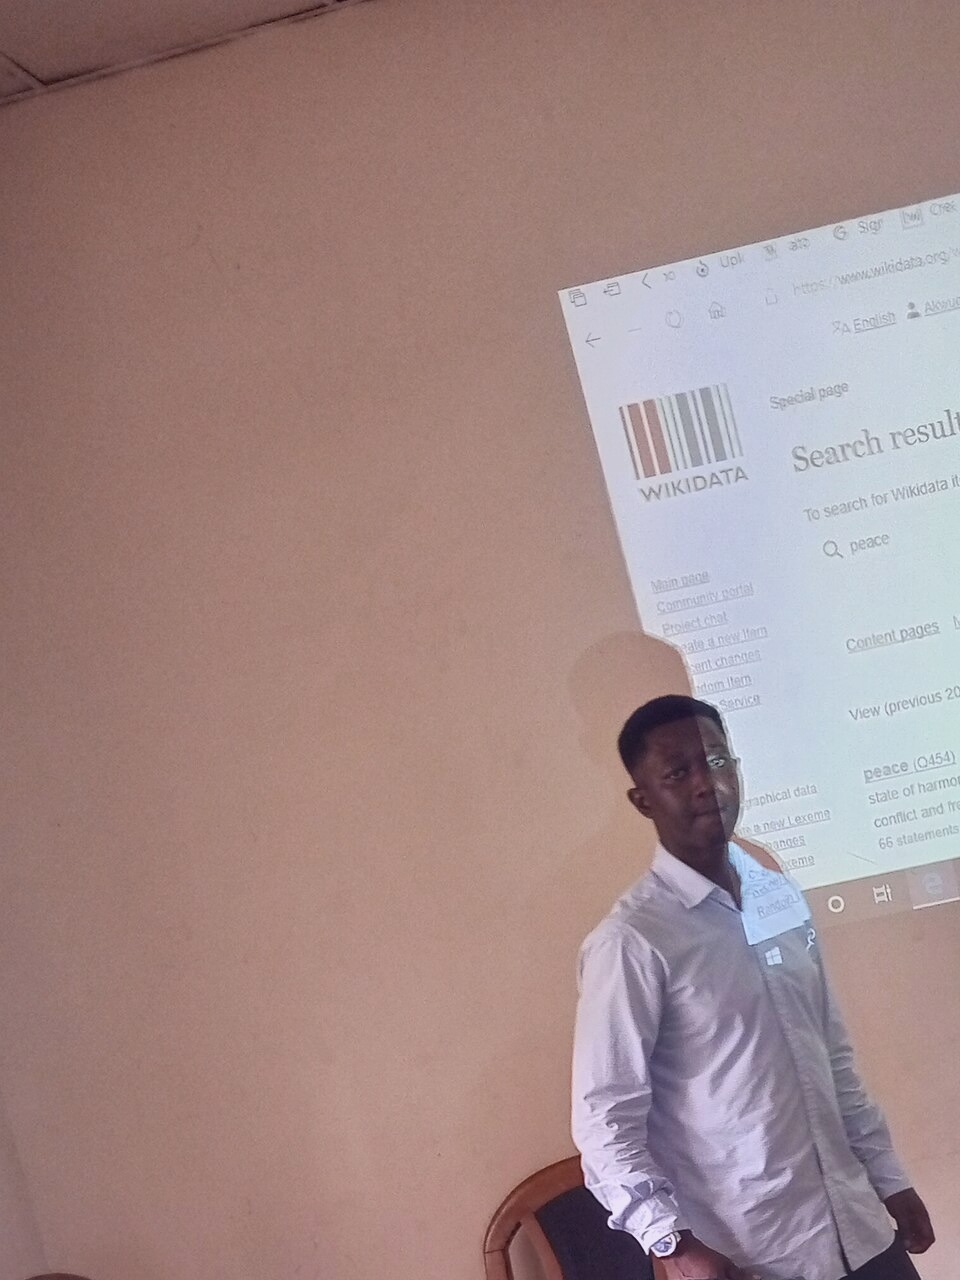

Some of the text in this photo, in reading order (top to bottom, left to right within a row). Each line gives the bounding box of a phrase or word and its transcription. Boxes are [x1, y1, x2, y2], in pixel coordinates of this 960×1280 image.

[853, 311, 897, 333] English
[769, 380, 850, 412] Special page
[791, 427, 884, 473] Search
[638, 465, 749, 503] WIKIDATA
[803, 506, 821, 523] To
[824, 496, 868, 520] search
[870, 492, 890, 509] for
[890, 479, 949, 503] Wikidata
[849, 532, 891, 557] peace
[650, 577, 679, 595] Main
[656, 590, 719, 617] Community
[661, 609, 729, 637] Project chat
[682, 638, 706, 655] eate
[717, 632, 742, 649] new
[845, 620, 941, 655] Content pages
[715, 649, 762, 671] changes
[697, 680, 727, 698] dom
[719, 693, 762, 715] Service
[849, 702, 881, 722] View
[884, 686, 942, 717] (previous
[863, 750, 957, 784] peace (Q454)
[793, 784, 818, 799] data
[868, 788, 900, 806] state
[901, 784, 915, 799] of
[763, 818, 786, 833] new
[787, 809, 832, 829] Lexeme
[873, 807, 919, 829] conflict
[920, 803, 945, 820] and
[878, 835, 895, 851] 66
